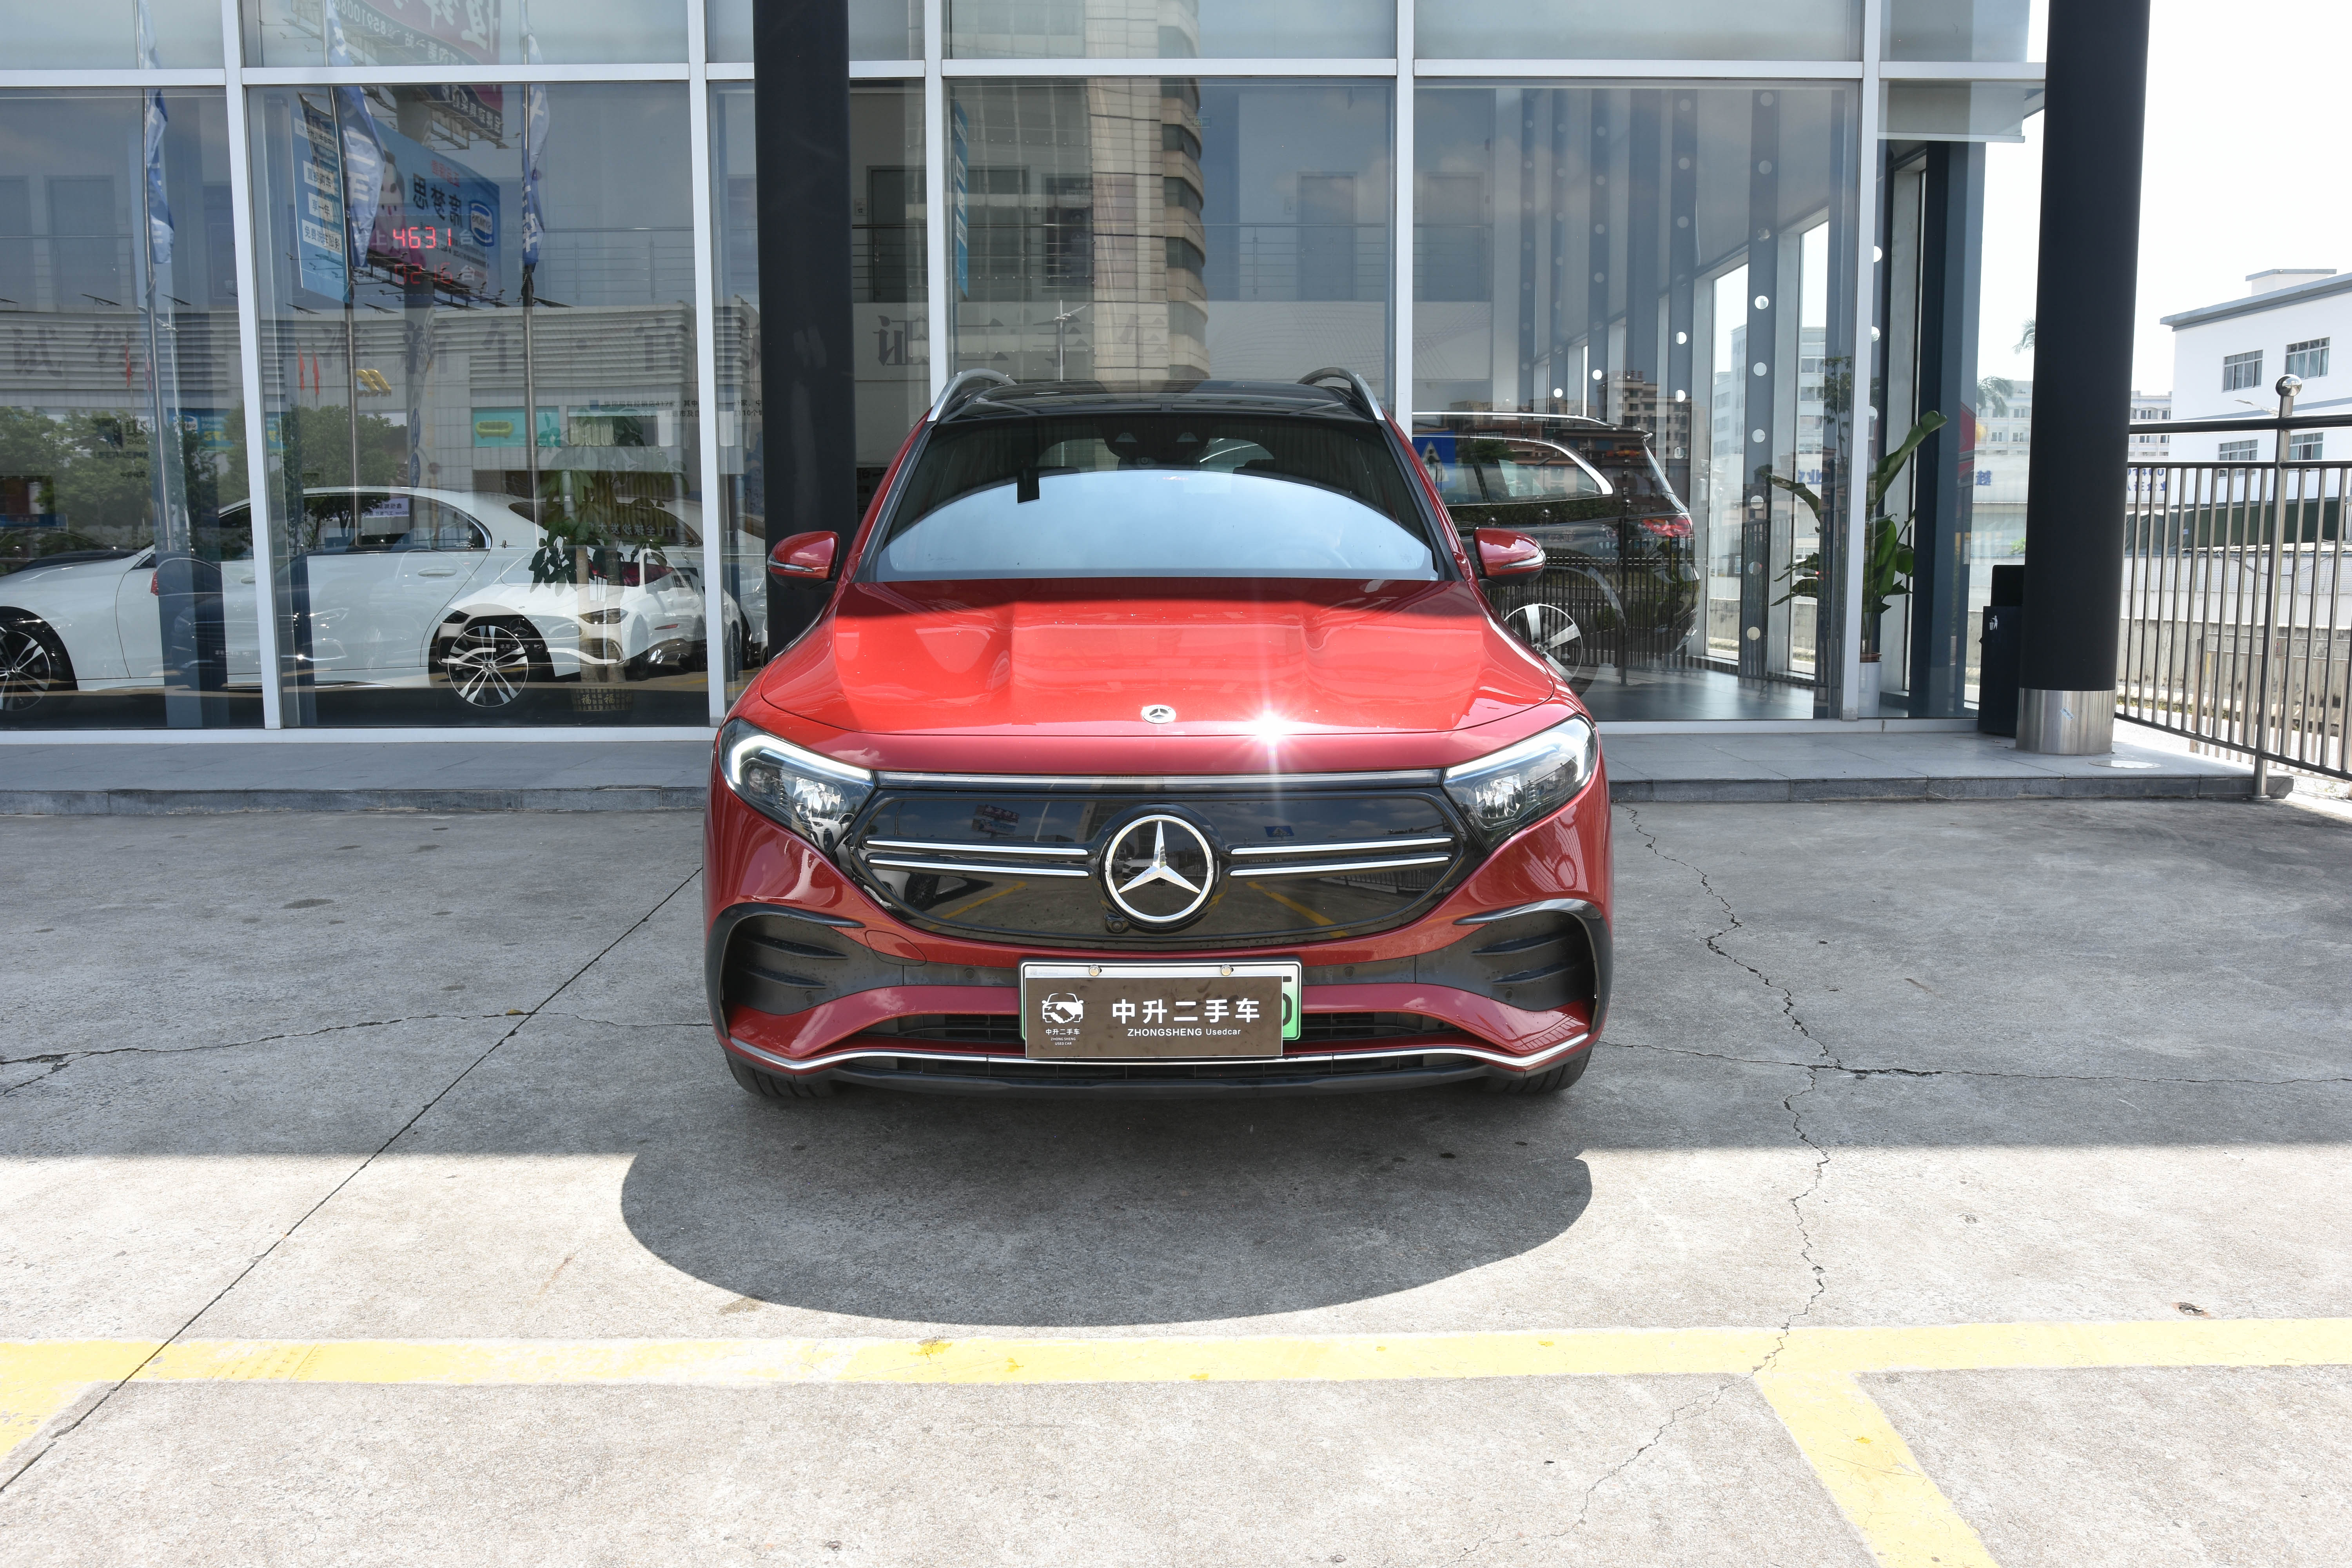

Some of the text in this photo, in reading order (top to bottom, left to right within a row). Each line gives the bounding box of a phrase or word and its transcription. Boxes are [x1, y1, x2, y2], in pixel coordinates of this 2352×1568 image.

[393, 227, 452, 249] 4631
[459, 229, 474, 245] 台
[460, 265, 475, 281] 台
[581, 694, 592, 705] 福
[604, 693, 615, 704] 福
[1112, 998, 1260, 1024] 中升二手车
[1127, 1028, 1202, 1037] ZHONGSHENG
